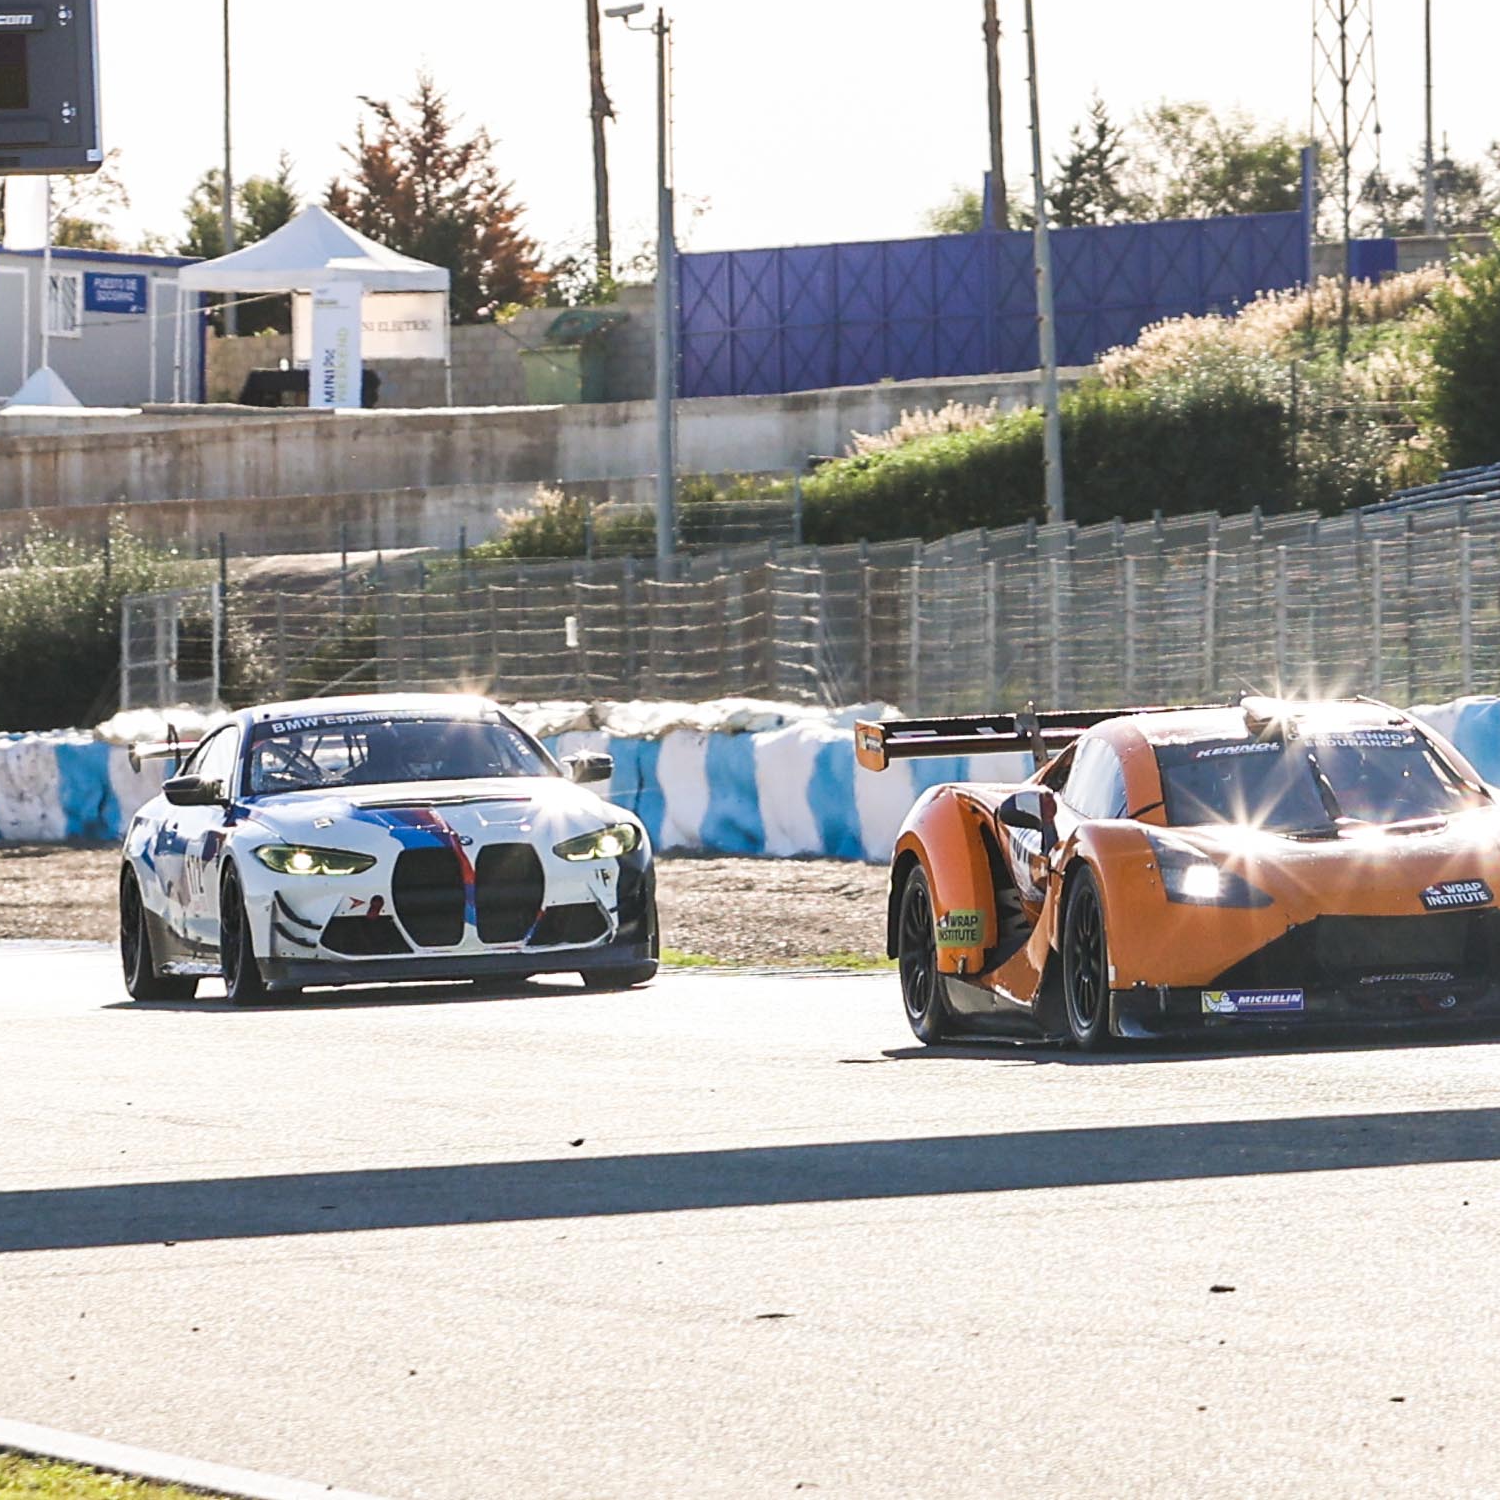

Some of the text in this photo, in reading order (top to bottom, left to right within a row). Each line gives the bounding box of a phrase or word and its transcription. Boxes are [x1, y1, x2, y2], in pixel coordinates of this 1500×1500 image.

[323, 369, 336, 403] MINI
[271, 717, 319, 733] BMW
[1196, 742, 1280, 758] KENNOL
[1442, 882, 1482, 894] WRAP
[1425, 891, 1489, 907] INSTITUTE
[1238, 993, 1301, 1005] MICHELIN
